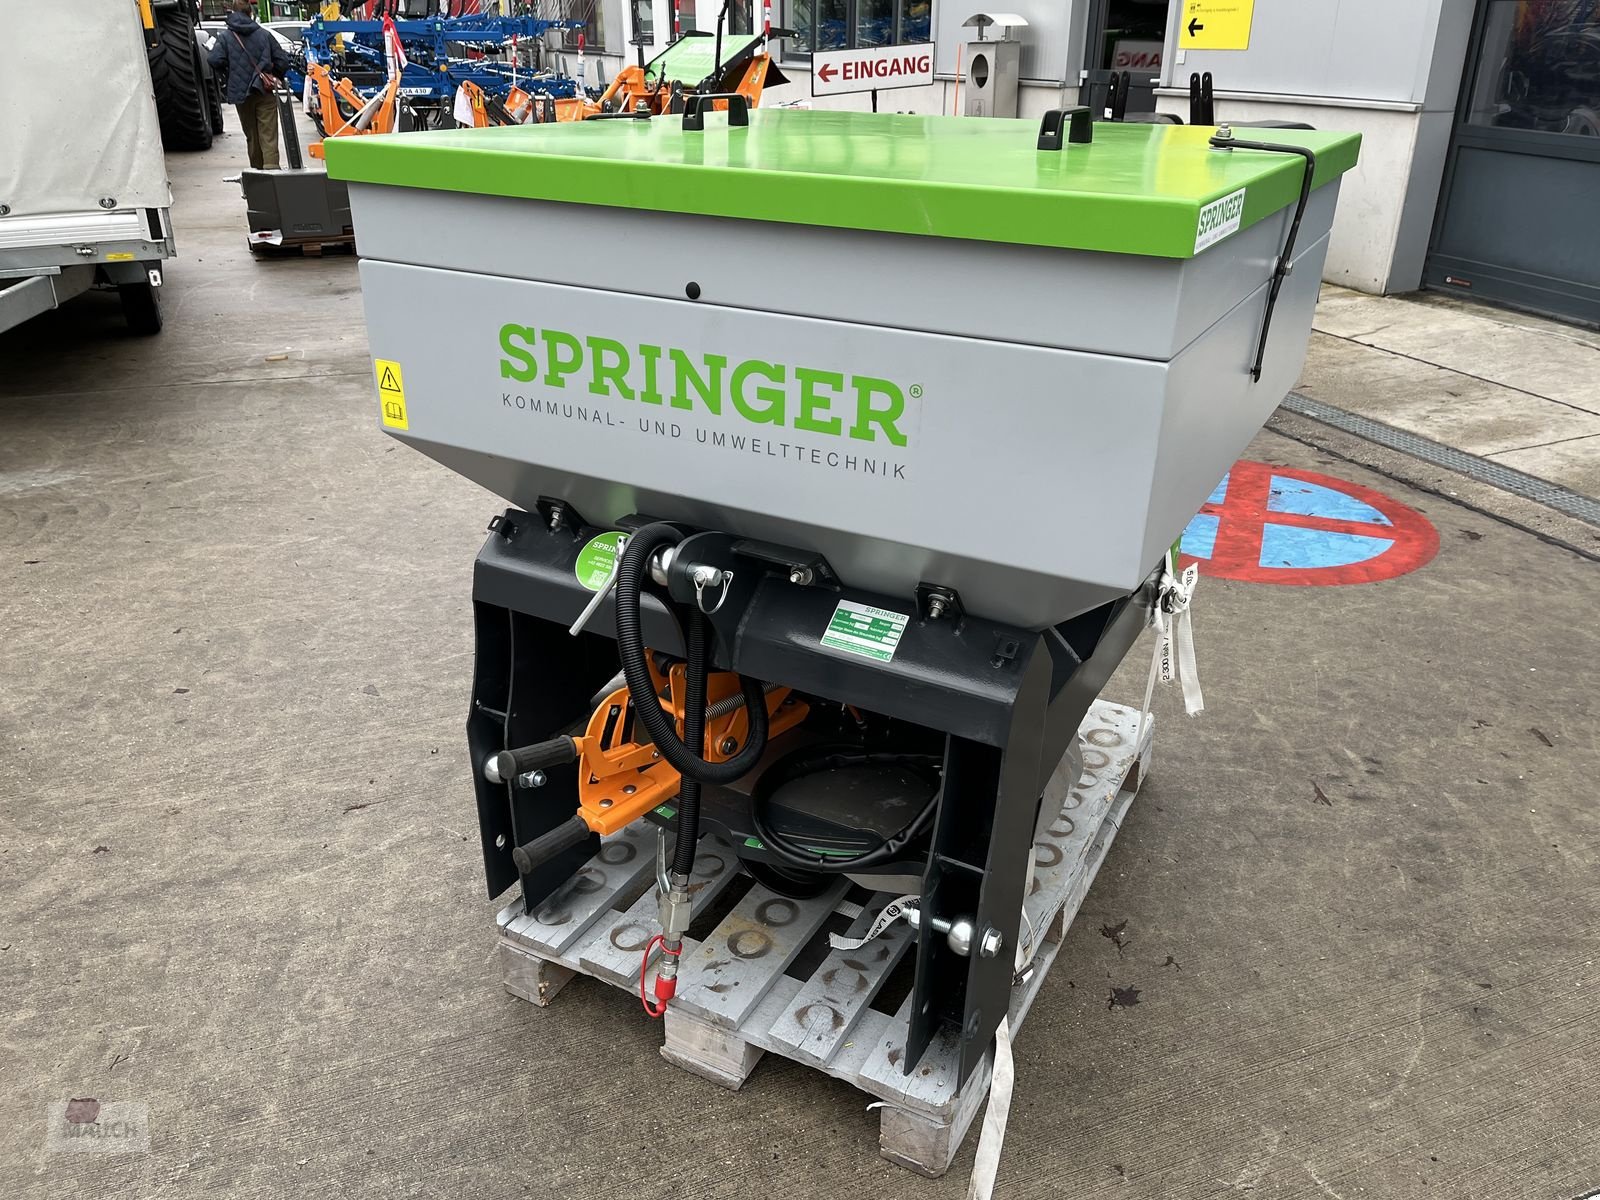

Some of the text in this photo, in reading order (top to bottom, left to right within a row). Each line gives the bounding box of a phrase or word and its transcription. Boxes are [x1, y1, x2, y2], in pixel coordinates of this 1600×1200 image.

[842, 55, 930, 80] EINGANG
[1199, 193, 1243, 236] SPRINGER
[502, 392, 906, 479] KOMMUNAL- UND UMWELTTECHNIK
[592, 541, 616, 553] SPRIN
[864, 606, 907, 621] SPRINGER
